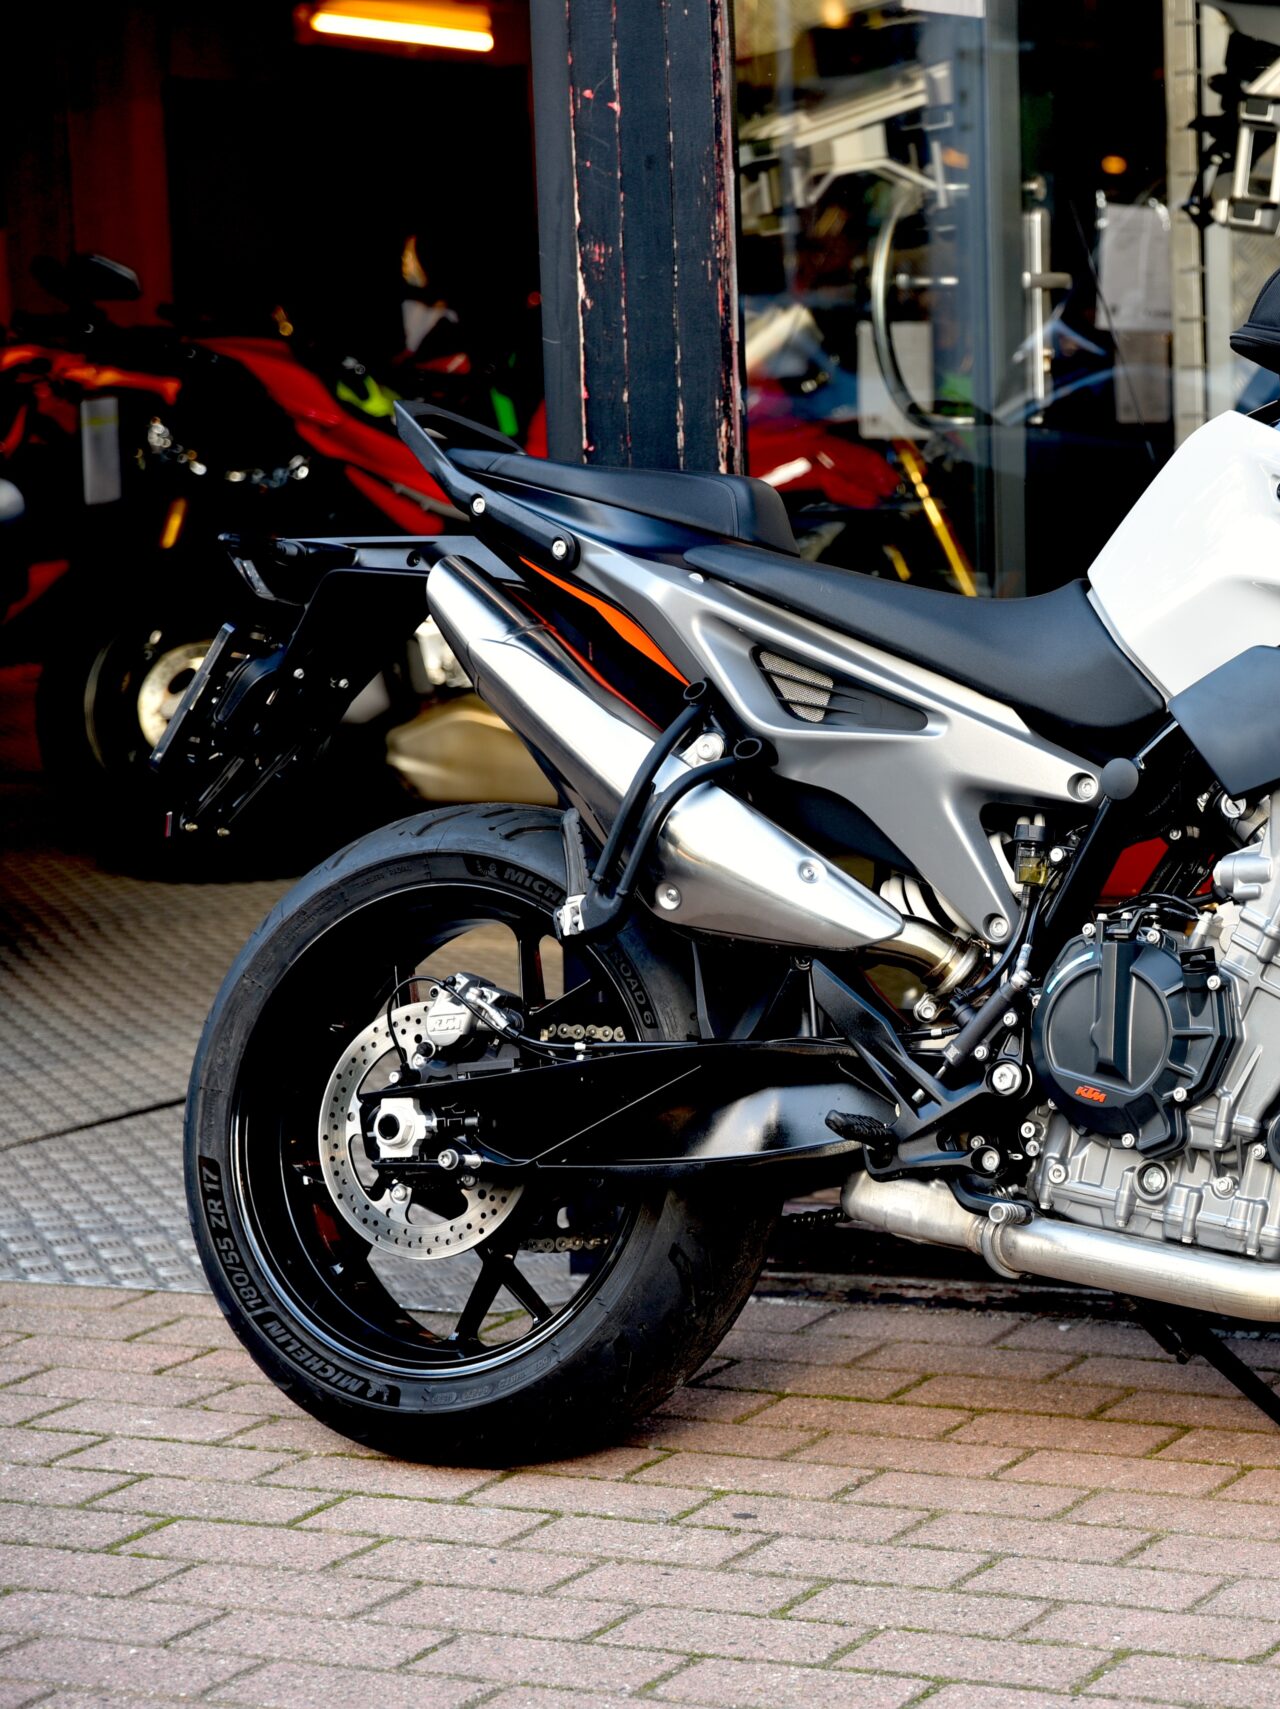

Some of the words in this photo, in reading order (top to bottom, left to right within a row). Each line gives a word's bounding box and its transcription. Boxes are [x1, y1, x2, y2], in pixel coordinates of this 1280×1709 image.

[643, 1010, 655, 1025] 6
[1075, 1085, 1107, 1103] KTM
[202, 1166, 220, 1192] 17
[207, 1199, 228, 1230] ZR
[216, 1237, 263, 1309] 180/55
[263, 1319, 365, 1393] MICHELIN
